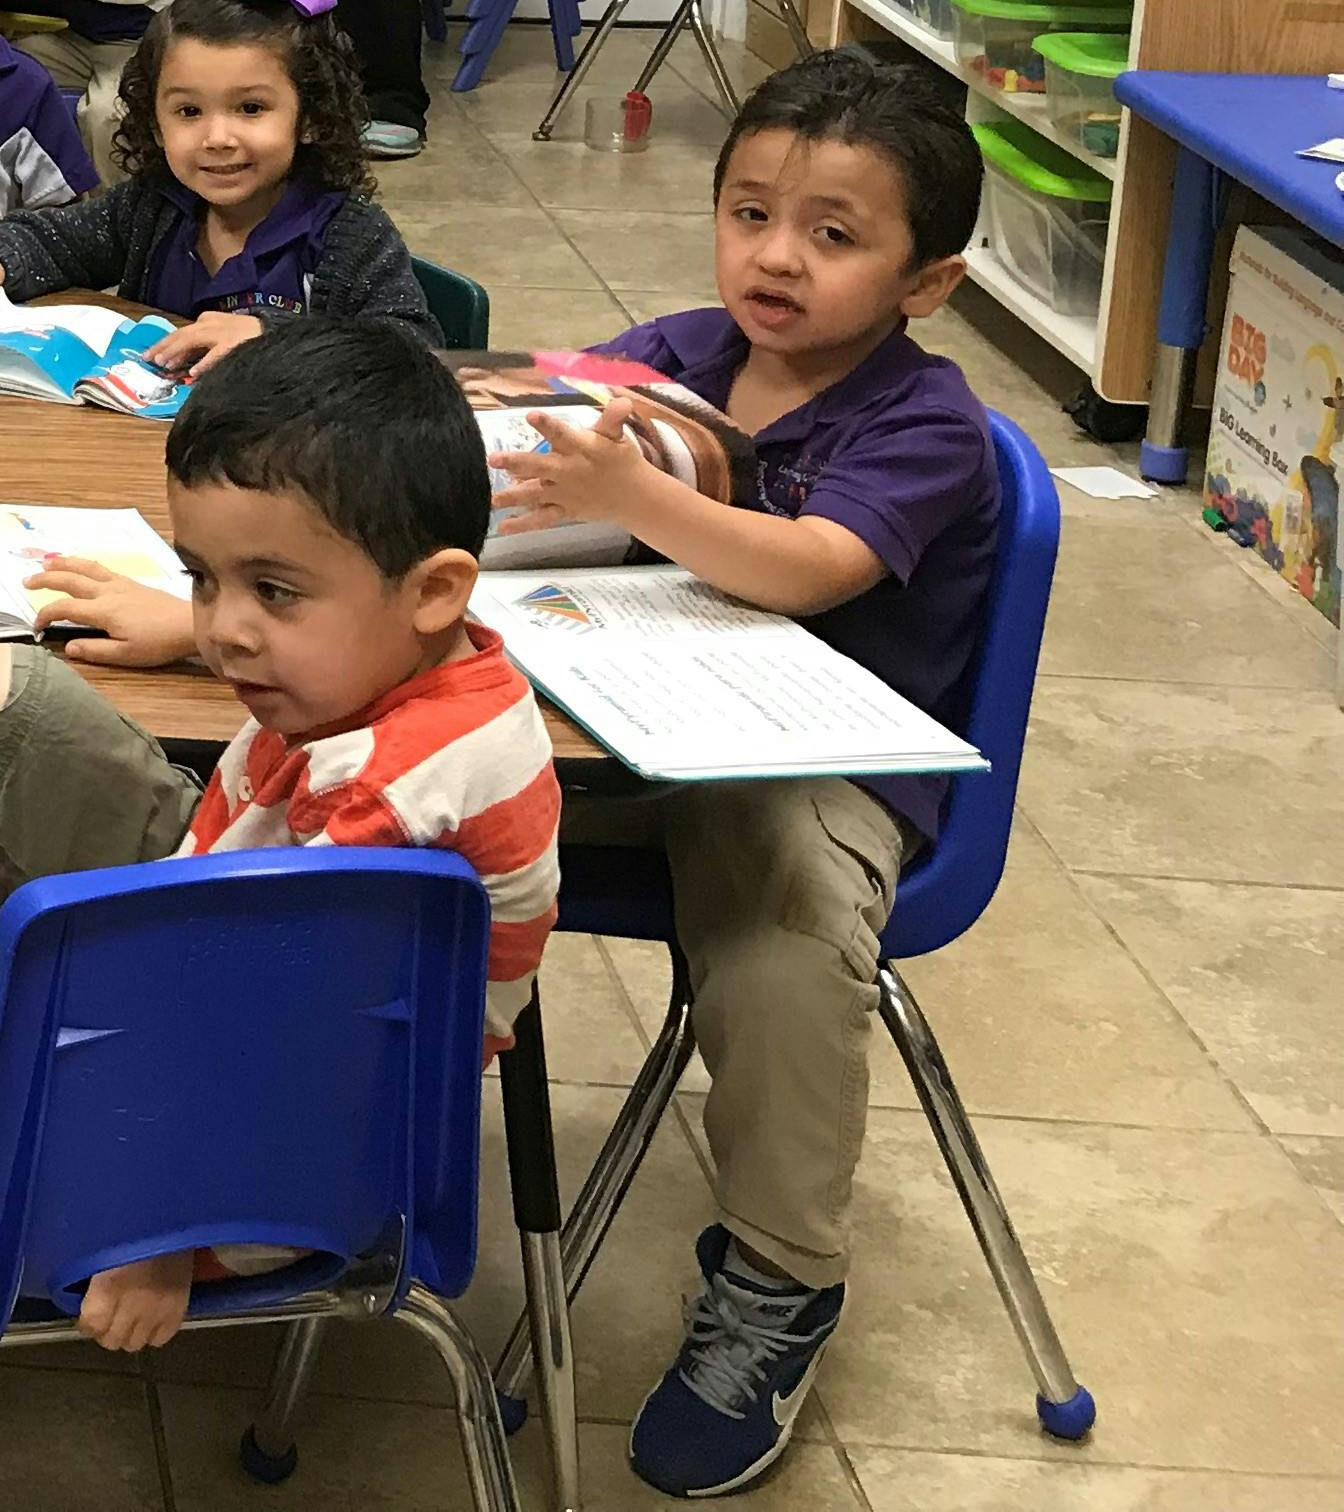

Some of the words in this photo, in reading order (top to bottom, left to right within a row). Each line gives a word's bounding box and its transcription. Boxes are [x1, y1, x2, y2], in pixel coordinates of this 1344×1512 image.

[1227, 344, 1265, 386] DAY
[1231, 314, 1267, 365] BIG
[1219, 407, 1235, 431] BIG
[1235, 421, 1272, 466] Learning
[1272, 450, 1289, 476] Box
